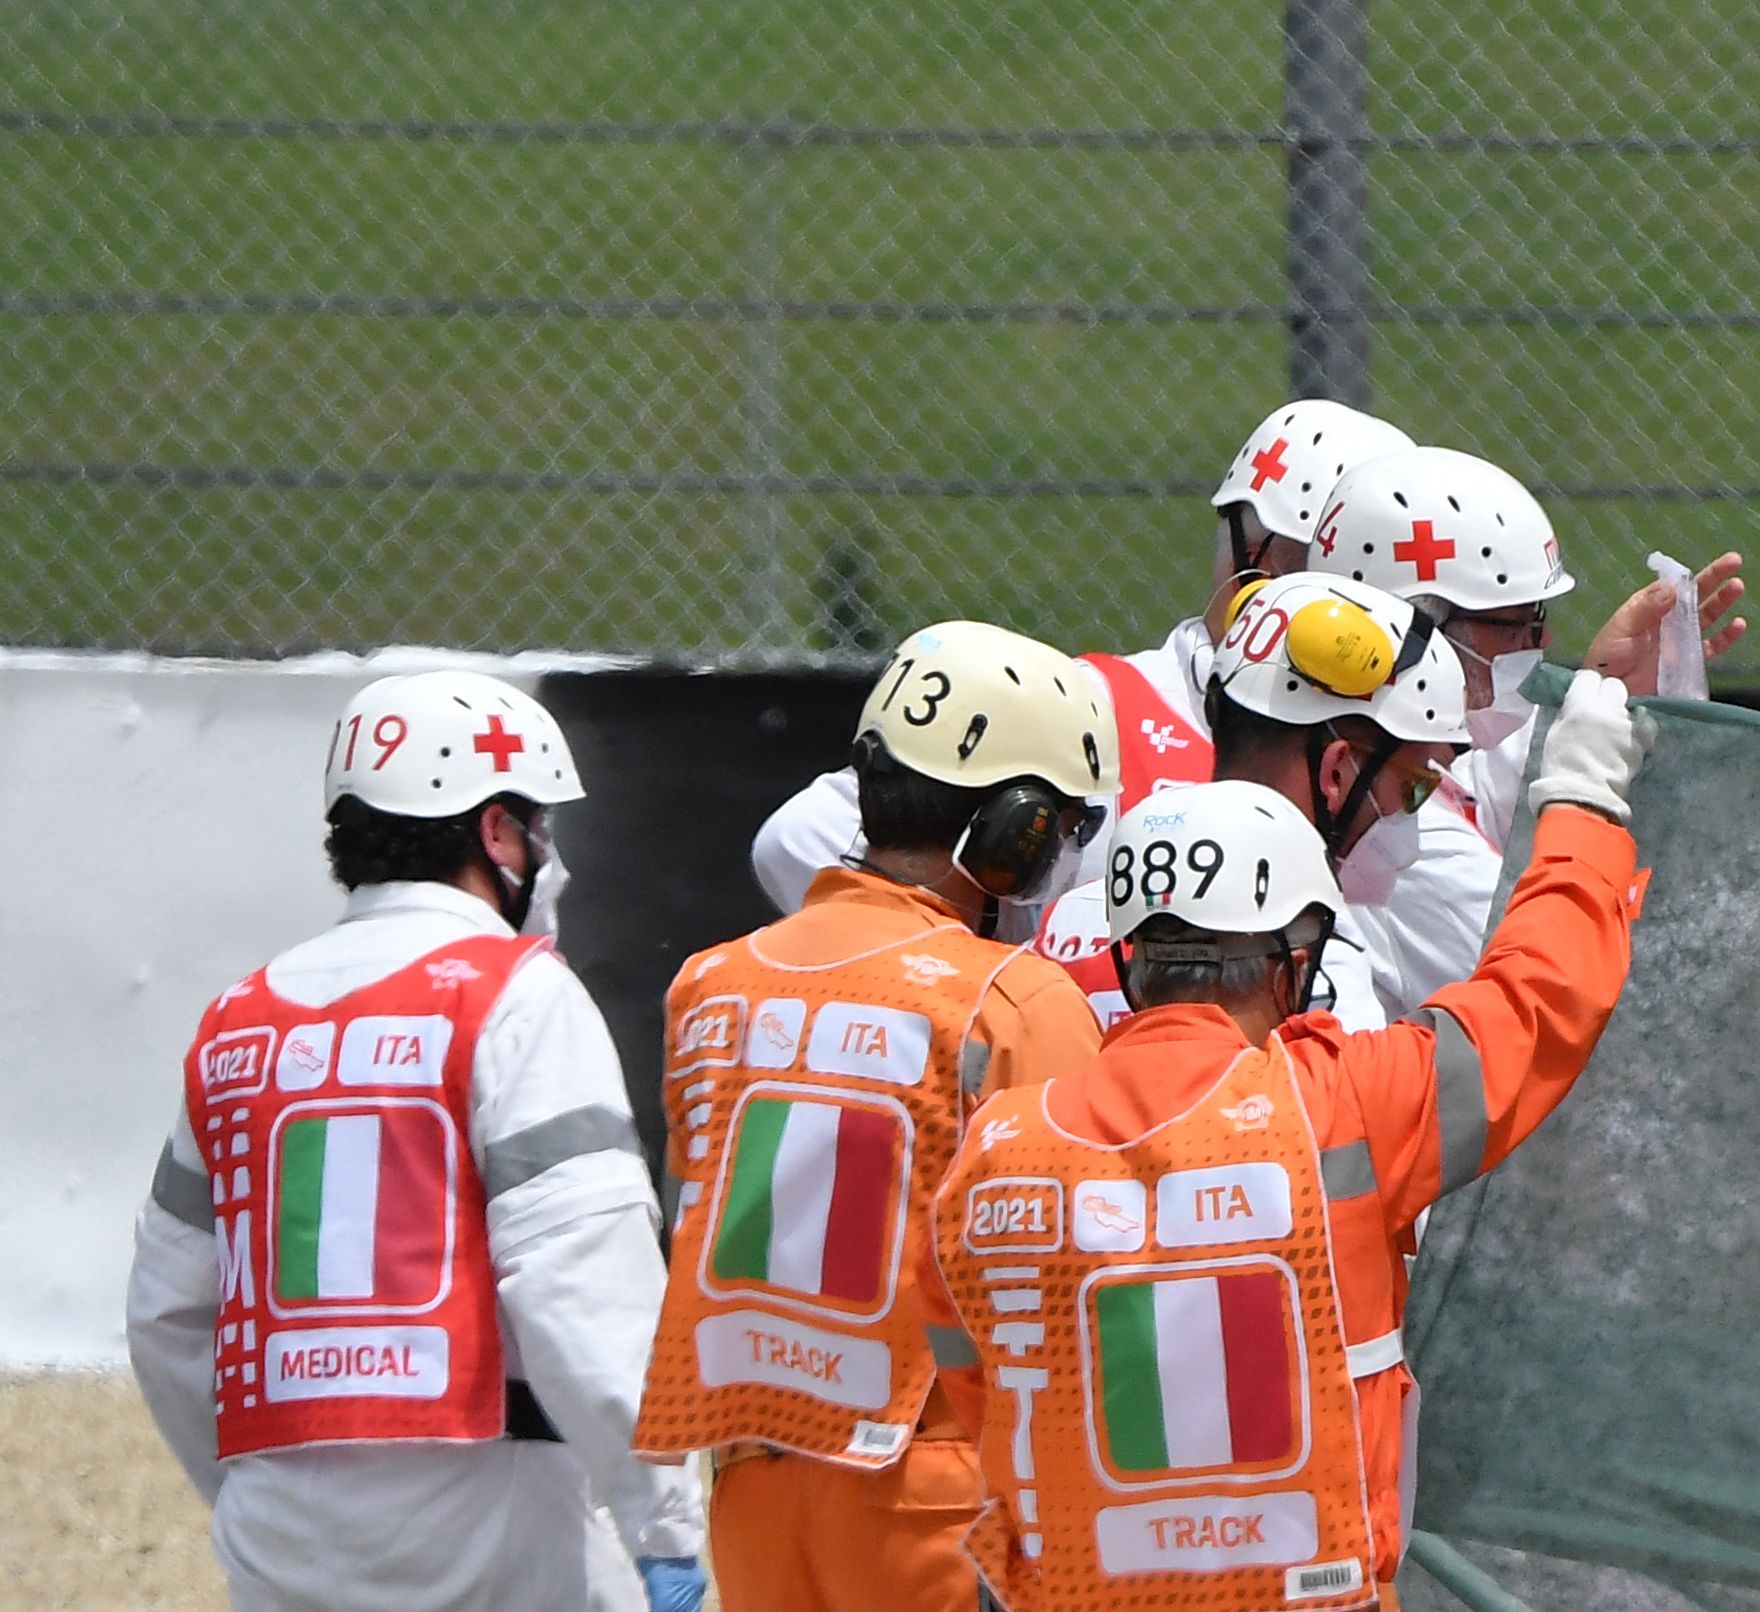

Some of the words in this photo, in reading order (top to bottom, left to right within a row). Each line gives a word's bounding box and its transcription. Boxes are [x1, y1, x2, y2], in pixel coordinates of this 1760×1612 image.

[1225, 598, 1290, 663] 50
[326, 714, 408, 775] 19
[1110, 839, 1224, 907] 889
[372, 1035, 424, 1066] ITA
[841, 1022, 888, 1058] ITA
[972, 1197, 1047, 1235] 2021
[1194, 1184, 1253, 1222] ITA
[280, 1343, 420, 1381] MEDICAL
[745, 1328, 845, 1385] TRACK
[1148, 1513, 1265, 1550] TRACK
